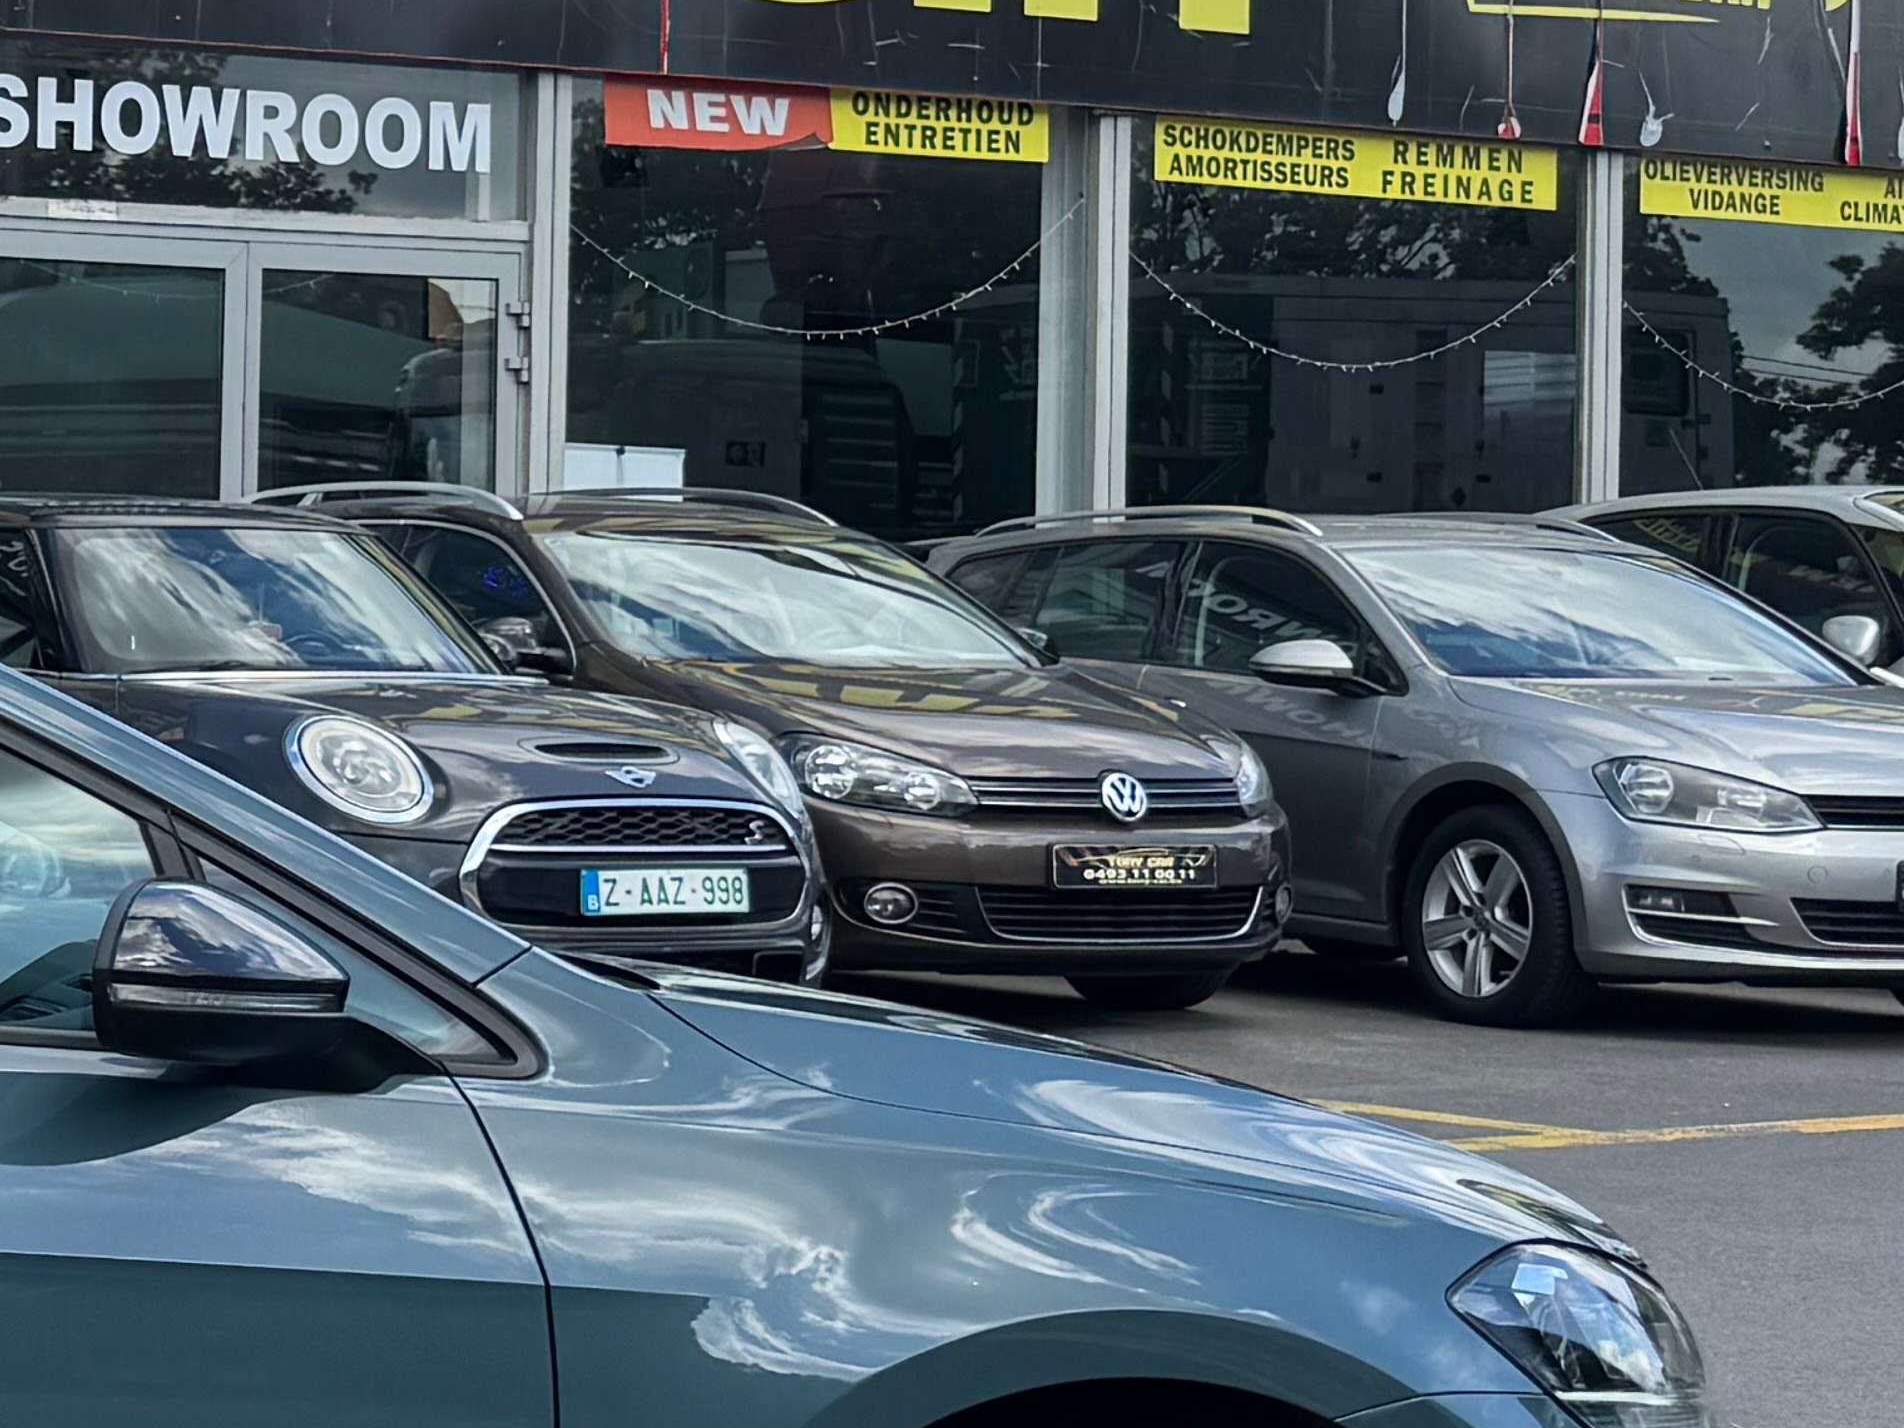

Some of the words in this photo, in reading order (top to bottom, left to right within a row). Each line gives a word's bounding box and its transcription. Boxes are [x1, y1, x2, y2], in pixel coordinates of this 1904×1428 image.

[646, 89, 789, 136] NEW
[852, 91, 1034, 126] ONDERHOUD
[865, 122, 1021, 154] ENTRETIEN
[1163, 124, 1355, 161] SCHOKDEMPERS
[1169, 153, 1349, 189] AMORTISSEURS
[1393, 141, 1523, 173] REMMEN
[1381, 171, 1533, 203] FREINAGE
[1644, 159, 1824, 192] OLIEVERVERSING
[1689, 188, 1781, 215] VIDANGE
[1840, 201, 1904, 224] CLIMA
[588, 895, 600, 909] B
